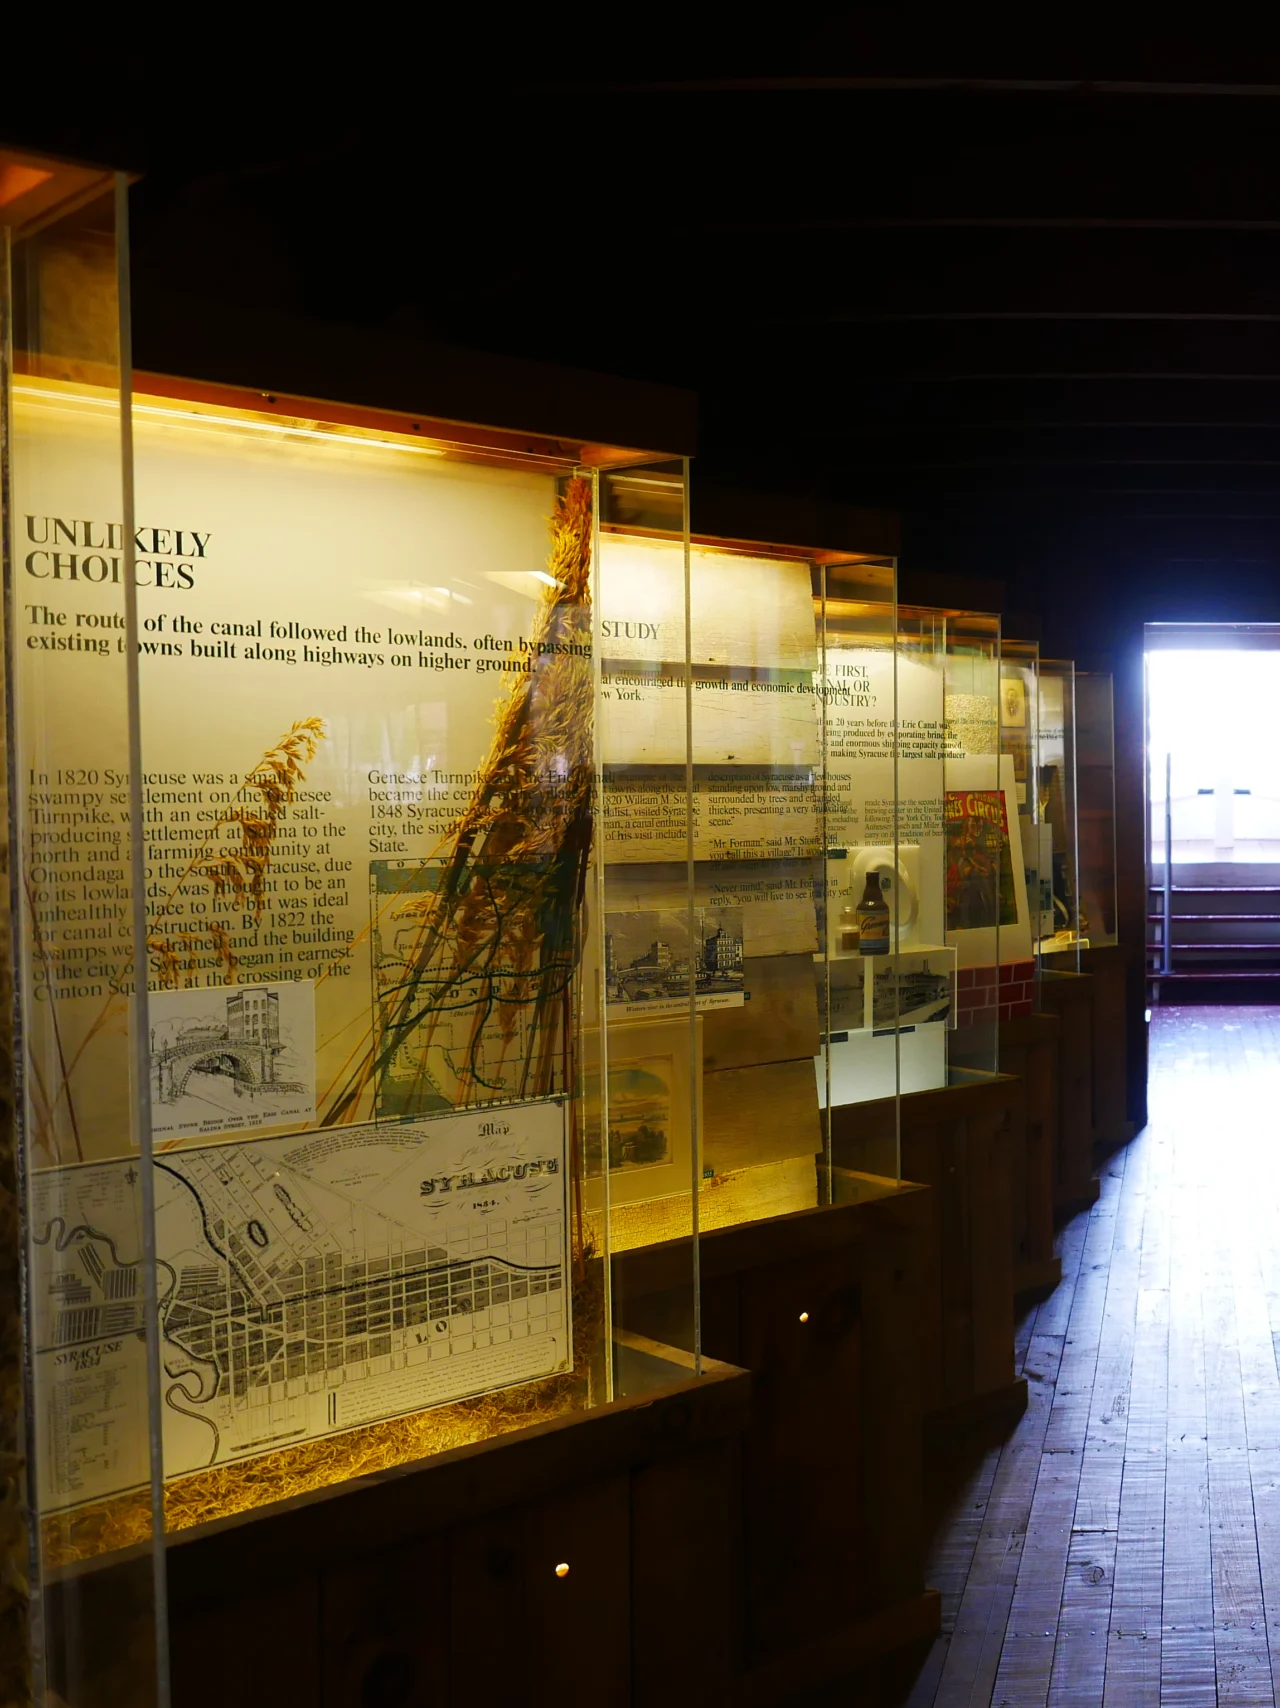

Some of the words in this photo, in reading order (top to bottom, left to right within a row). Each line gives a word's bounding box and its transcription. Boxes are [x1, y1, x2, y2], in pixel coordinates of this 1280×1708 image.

[24, 515, 212, 558] UNLIKELY
[25, 550, 194, 590] CHOICES
[24, 604, 66, 626] The
[144, 614, 166, 632] of
[172, 616, 202, 634] the
[211, 620, 261, 638] canal
[269, 620, 347, 643] followed
[354, 627, 380, 644] the
[388, 628, 467, 650] lowlands,
[474, 634, 512, 652] often
[519, 637, 592, 658] bypassing
[602, 621, 660, 640] STUDY
[26, 632, 110, 656] existing
[191, 639, 236, 658] built
[244, 643, 296, 664] along
[303, 646, 384, 668] highways
[390, 653, 412, 667] on
[418, 651, 470, 672] higher
[476, 654, 536, 673] ground.
[615, 672, 672, 689] encouraged
[695, 680, 728, 692] growth
[731, 680, 748, 691] and
[752, 681, 794, 694] economic
[797, 683, 850, 696] development
[854, 680, 870, 692] OR
[836, 718, 844, 726] 20
[846, 720, 864, 728] years
[866, 718, 887, 728] before
[902, 720, 916, 729] Erie
[918, 720, 937, 729] Canal
[843, 729, 875, 738] produced
[877, 729, 885, 738] by
[831, 739, 843, 747] and
[846, 739, 880, 747] enormous
[912, 742, 938, 750] capacity
[940, 740, 961, 749] caused
[831, 748, 857, 757] making
[858, 749, 888, 759] Syracuse
[902, 750, 922, 759] largest
[938, 751, 965, 760] producer
[57, 770, 98, 785] 1820
[368, 770, 427, 784] Genesee
[29, 792, 103, 808] swampy
[267, 789, 331, 803] Genesee
[369, 789, 422, 801] became
[428, 789, 448, 801] the
[30, 808, 115, 827] Turnpike,
[197, 806, 287, 822] established
[292, 806, 325, 819] salt-
[370, 805, 403, 818] 1848
[407, 804, 468, 821] Syracuse
[967, 793, 1004, 827] CIRCUS
[31, 828, 120, 847] producing
[246, 823, 297, 839] Salina
[369, 823, 397, 838] city,
[402, 822, 423, 834] the
[31, 847, 80, 863] north
[148, 844, 213, 860] farming
[220, 842, 310, 859] community
[369, 839, 408, 852] State.
[30, 867, 124, 884] Onondaga
[215, 879, 278, 896] thought
[212, 898, 239, 913] live
[313, 893, 348, 908] ideal
[63, 925, 112, 942] canal
[270, 912, 305, 927] 1822
[32, 944, 106, 961] swamps
[161, 936, 221, 953] drained
[292, 928, 355, 945] building
[88, 961, 118, 980] city
[150, 955, 223, 979] Syracuse
[229, 951, 273, 970] began
[298, 947, 355, 961] earnest.
[237, 966, 302, 985] crossing
[478, 1123, 509, 1136] Map
[420, 1158, 559, 1197] SYRACUSE
[55, 1340, 123, 1365] SYRACUSE
